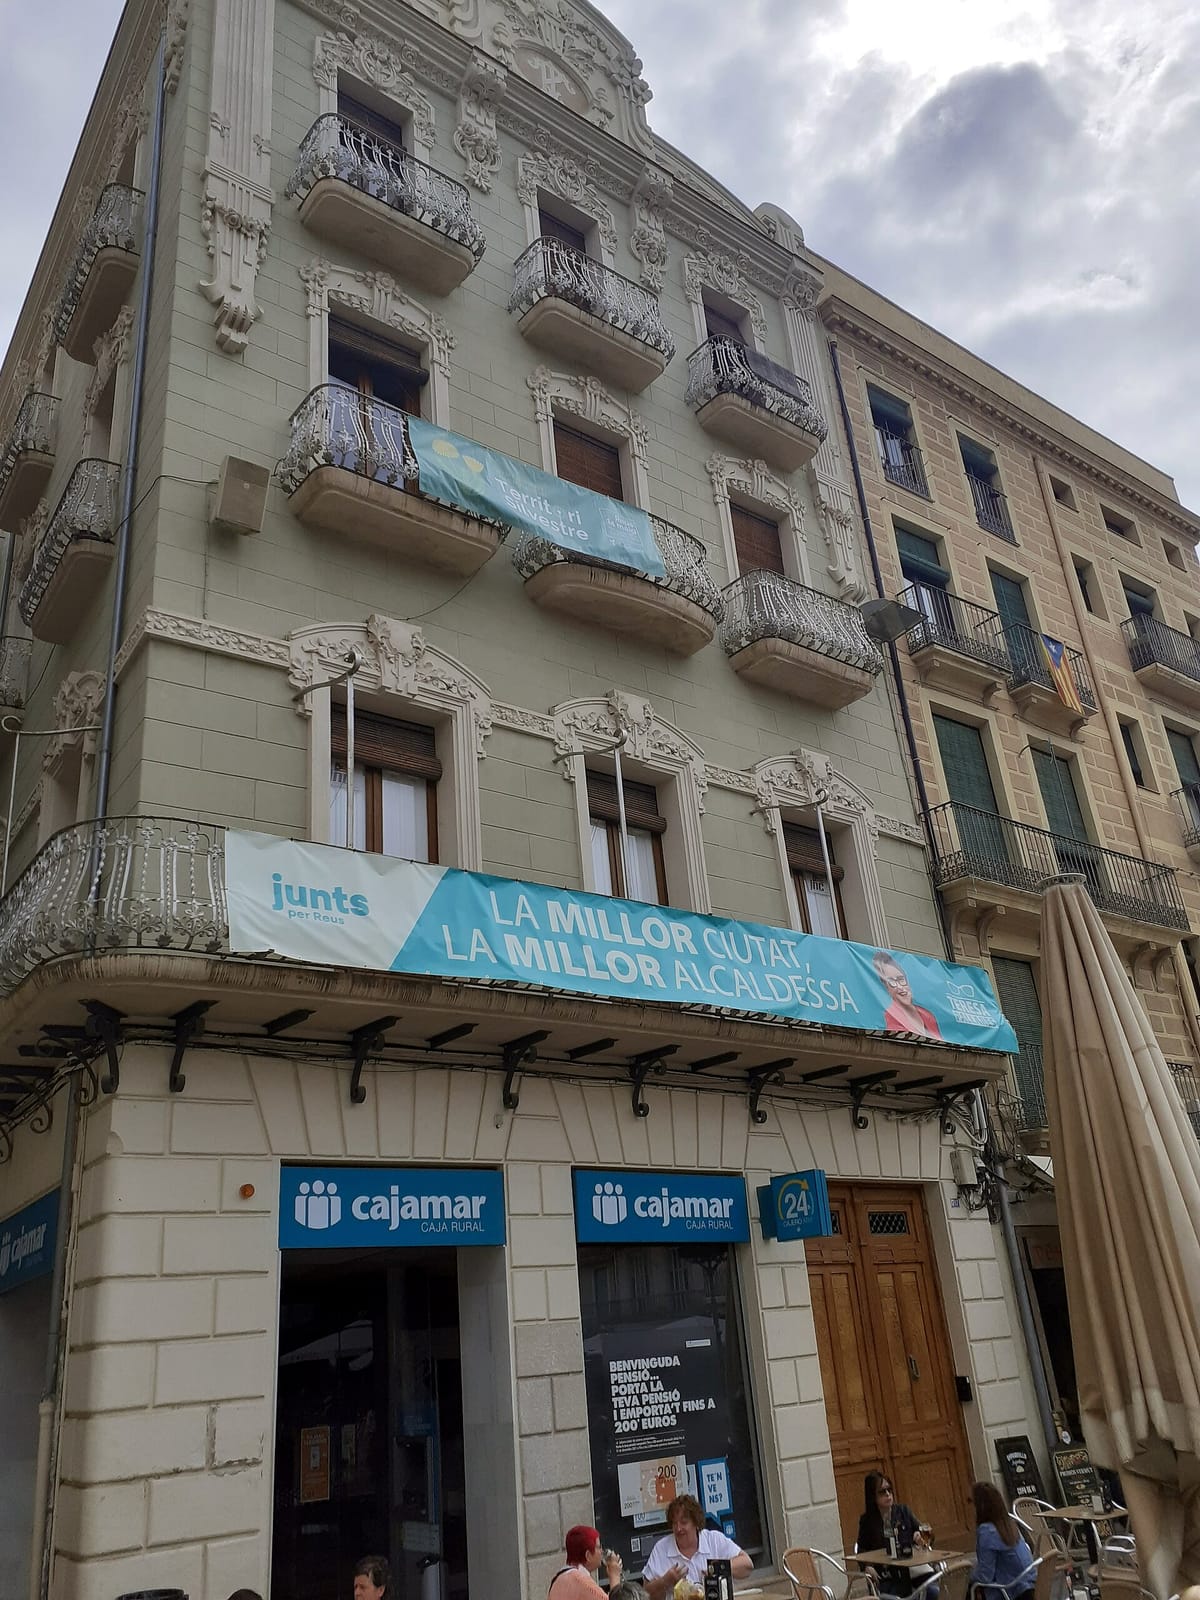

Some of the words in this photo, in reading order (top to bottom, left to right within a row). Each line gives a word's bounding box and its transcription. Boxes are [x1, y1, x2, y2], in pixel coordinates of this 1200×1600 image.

[505, 494, 589, 541] Silvestre
[271, 873, 370, 917] junts
[288, 908, 312, 922] per
[313, 911, 345, 926] Reus
[489, 890, 540, 930] LA
[546, 900, 698, 955] MILLOR
[441, 924, 498, 964] LA
[504, 934, 675, 989] MILLOR
[675, 960, 860, 1015] ALCALDESSA
[351, 1185, 487, 1231] cajamar
[633, 1187, 734, 1228] cajamar
[420, 1221, 448, 1233] CAJA
[451, 1221, 485, 1233] RURAL
[685, 1219, 706, 1231] CAJA
[708, 1219, 734, 1230] RURAL
[609, 1355, 681, 1373] BENVINGUDA
[610, 1368, 660, 1385] PENSIÓ...
[611, 1382, 648, 1397] PORTA
[649, 1380, 665, 1392] LA
[612, 1395, 640, 1409] TEVA
[641, 1388, 681, 1406] PENSIÓ
[613, 1409, 618, 1421] I
[620, 1401, 681, 1420] EMPORTA'T
[682, 1399, 706, 1413] FINS
[707, 1398, 716, 1409] A
[641, 1414, 677, 1430] EUROS
[657, 1464, 677, 1480] 200
[707, 1484, 717, 1493] VE
[709, 1492, 723, 1504] NS?
